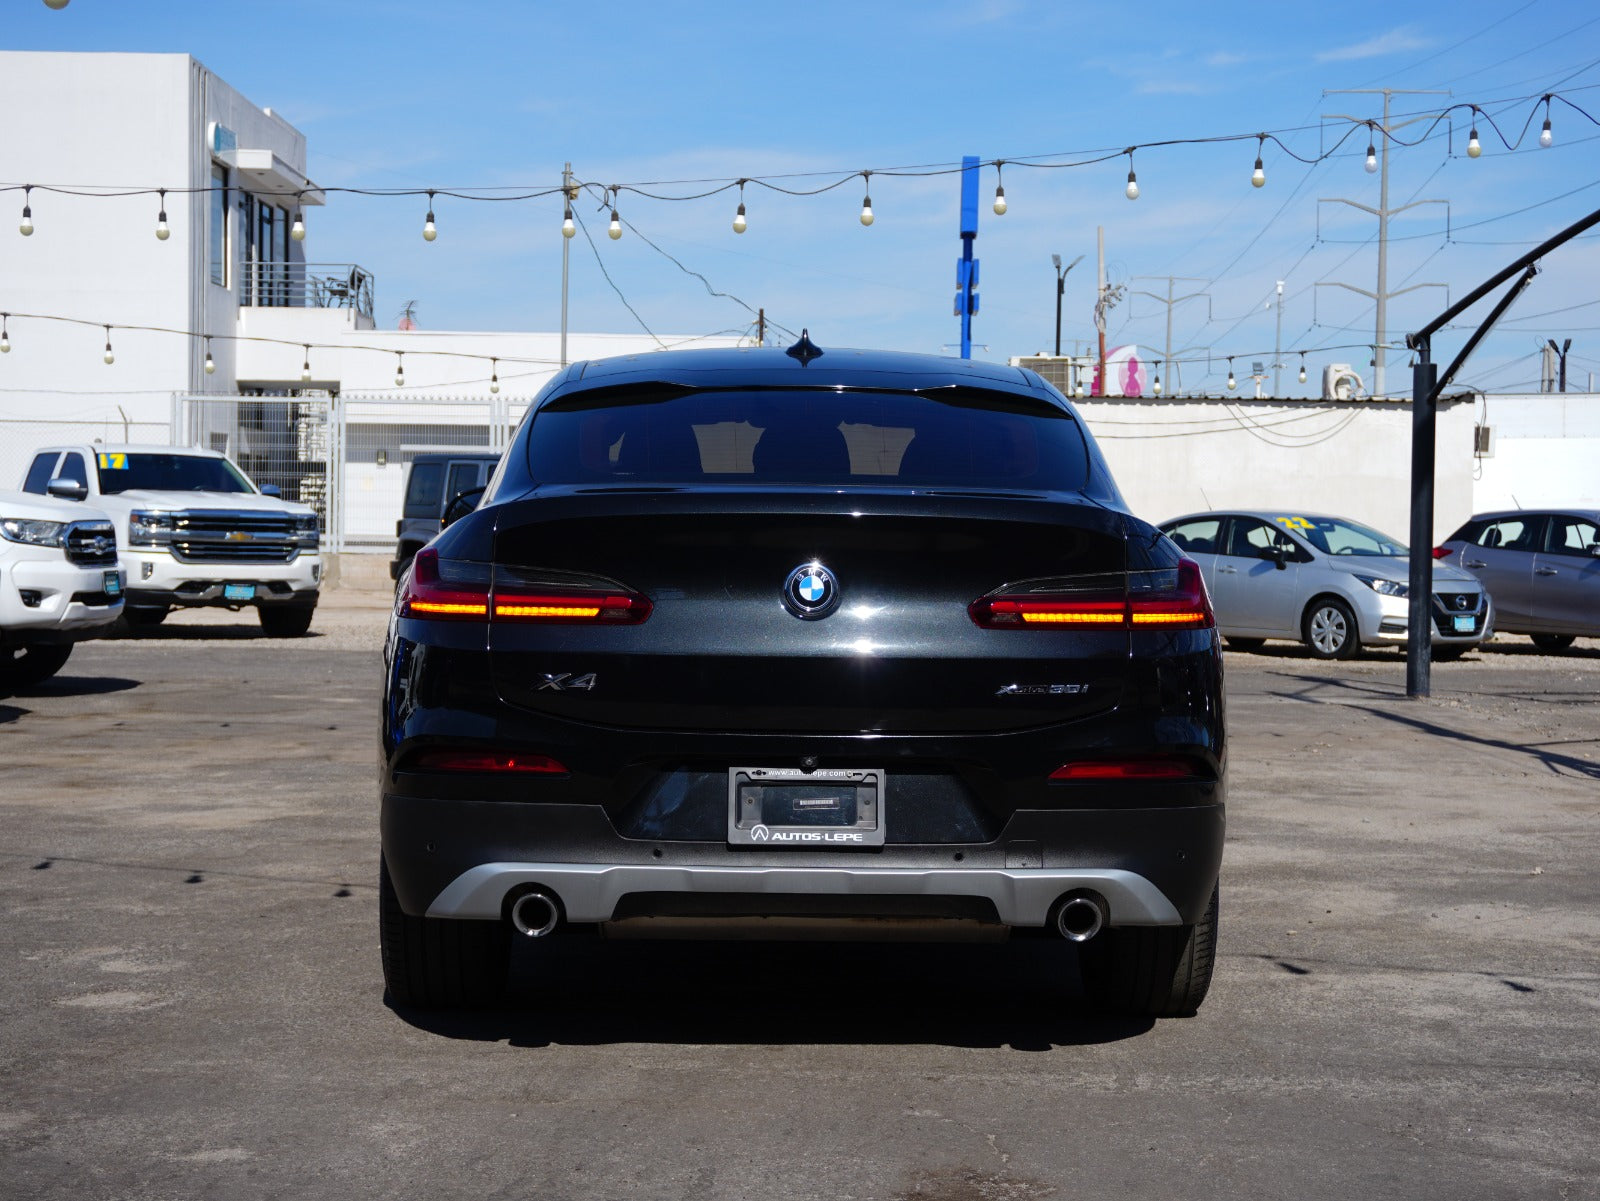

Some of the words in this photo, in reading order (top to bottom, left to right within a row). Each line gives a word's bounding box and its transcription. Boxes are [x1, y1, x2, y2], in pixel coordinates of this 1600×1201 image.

[100, 453, 125, 469] 17
[1276, 517, 1316, 529] 22
[537, 673, 597, 690] X4
